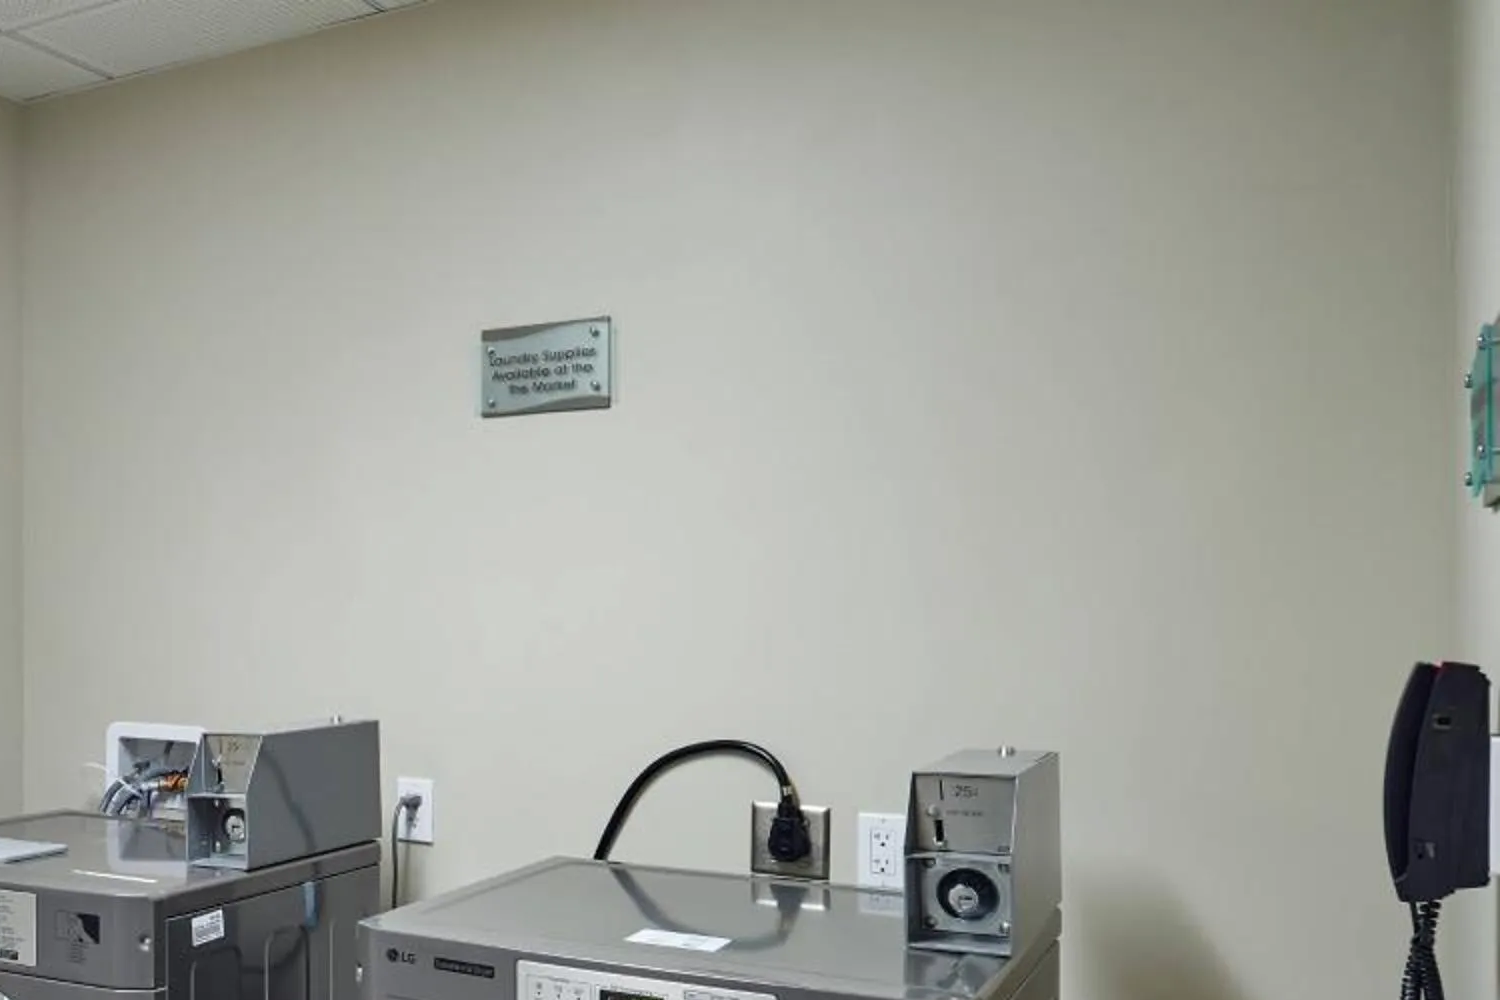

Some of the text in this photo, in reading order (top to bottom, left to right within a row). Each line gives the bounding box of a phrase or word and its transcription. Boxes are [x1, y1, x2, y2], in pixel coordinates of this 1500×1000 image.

[542, 347, 596, 362] Supplies
[492, 362, 593, 381] Available at the
[508, 379, 576, 395] the Market
